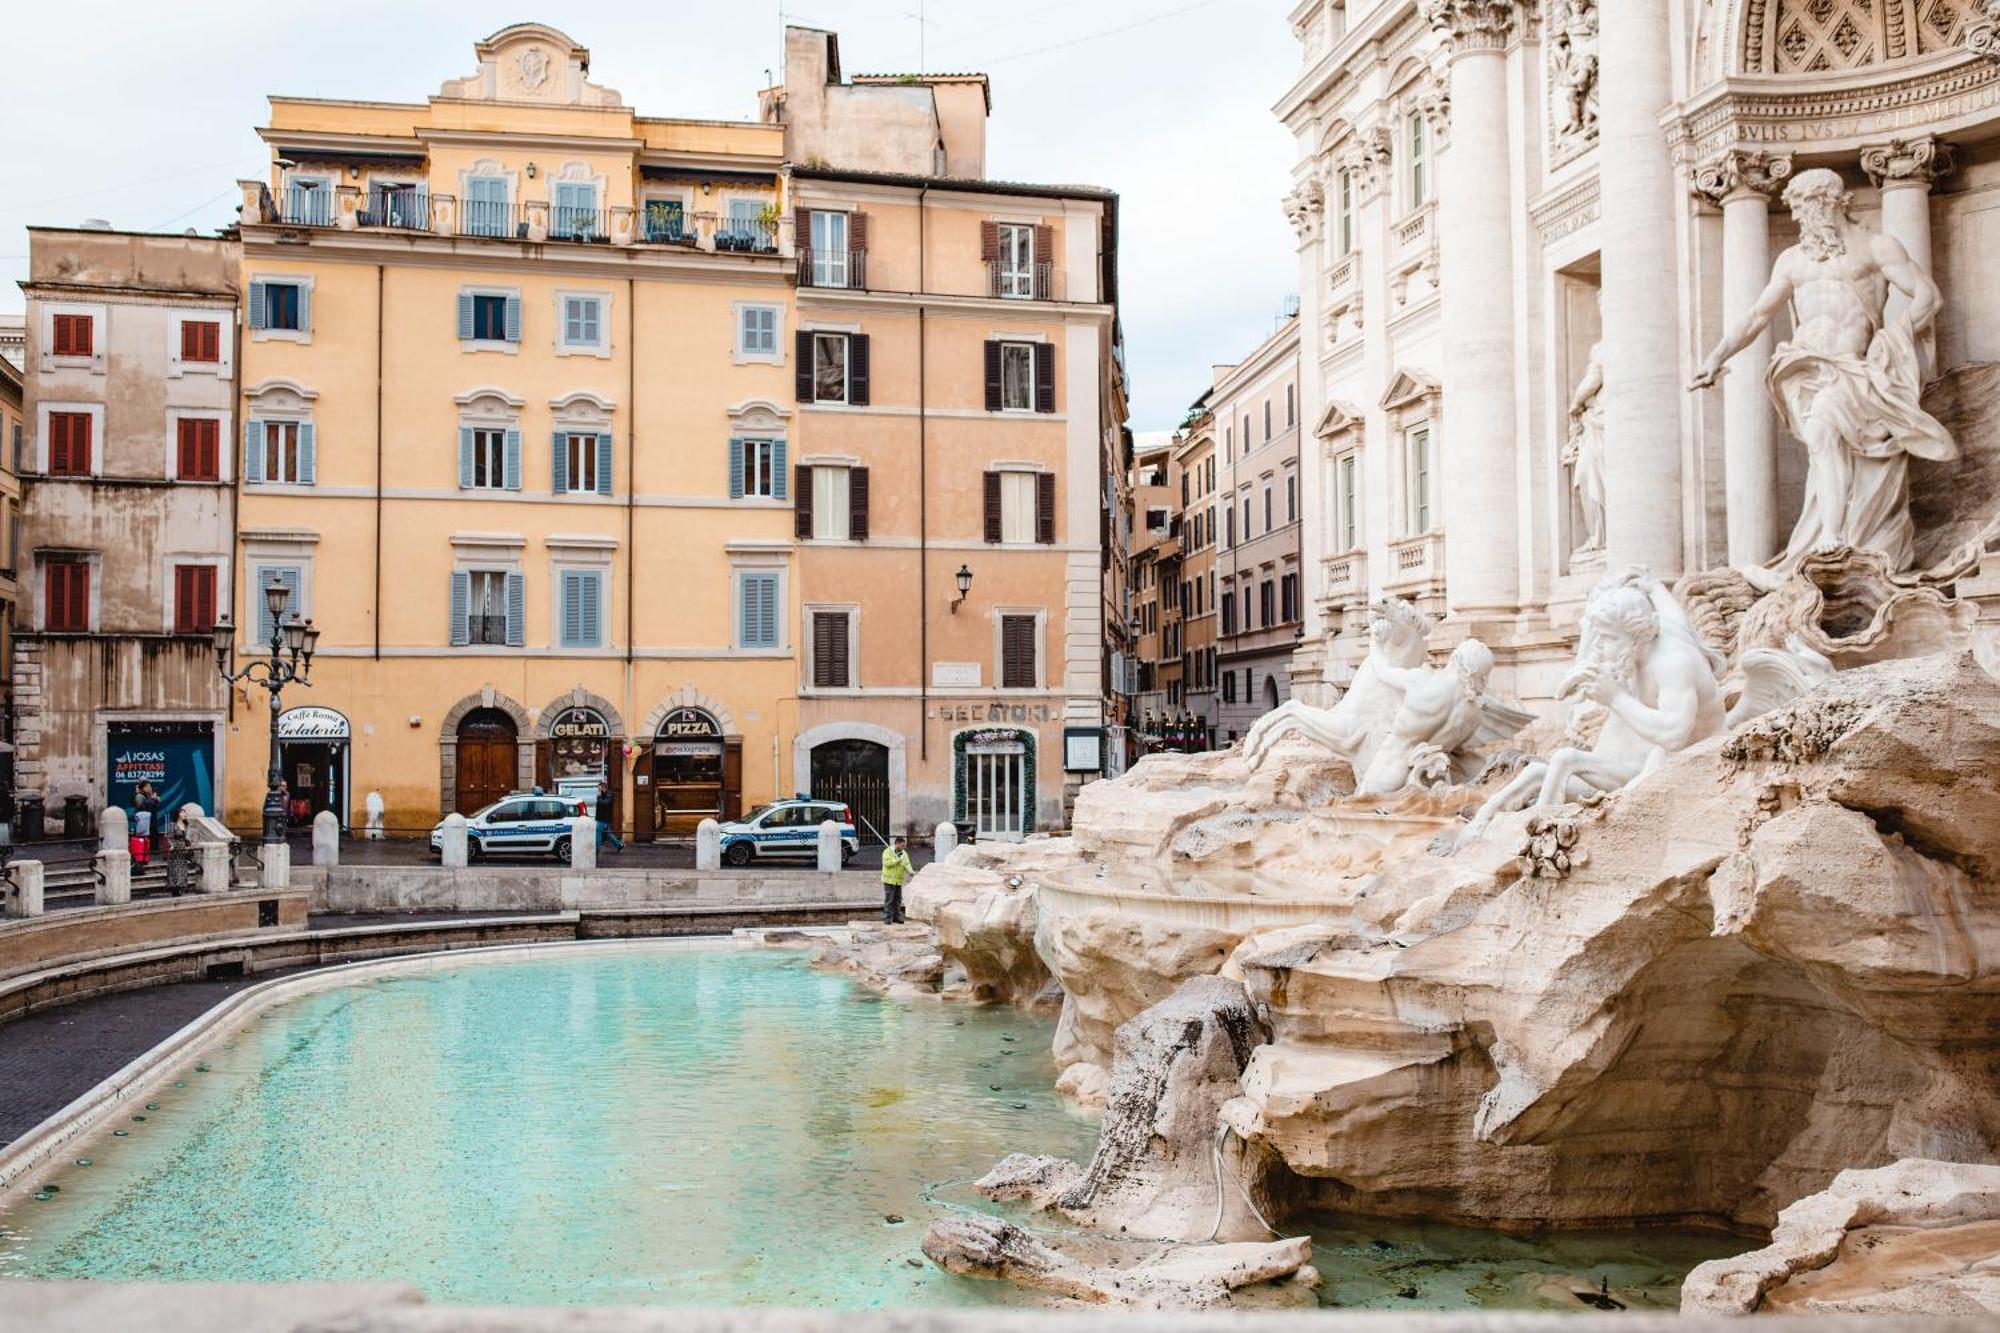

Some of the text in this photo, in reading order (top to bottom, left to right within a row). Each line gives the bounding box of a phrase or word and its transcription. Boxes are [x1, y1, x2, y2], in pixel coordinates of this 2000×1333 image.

[278, 722, 344, 735] Gelateria
[555, 723, 604, 736] GELATI
[667, 722, 712, 735] PIZZA
[132, 751, 165, 761] JOSAS
[115, 770, 126, 779] 06
